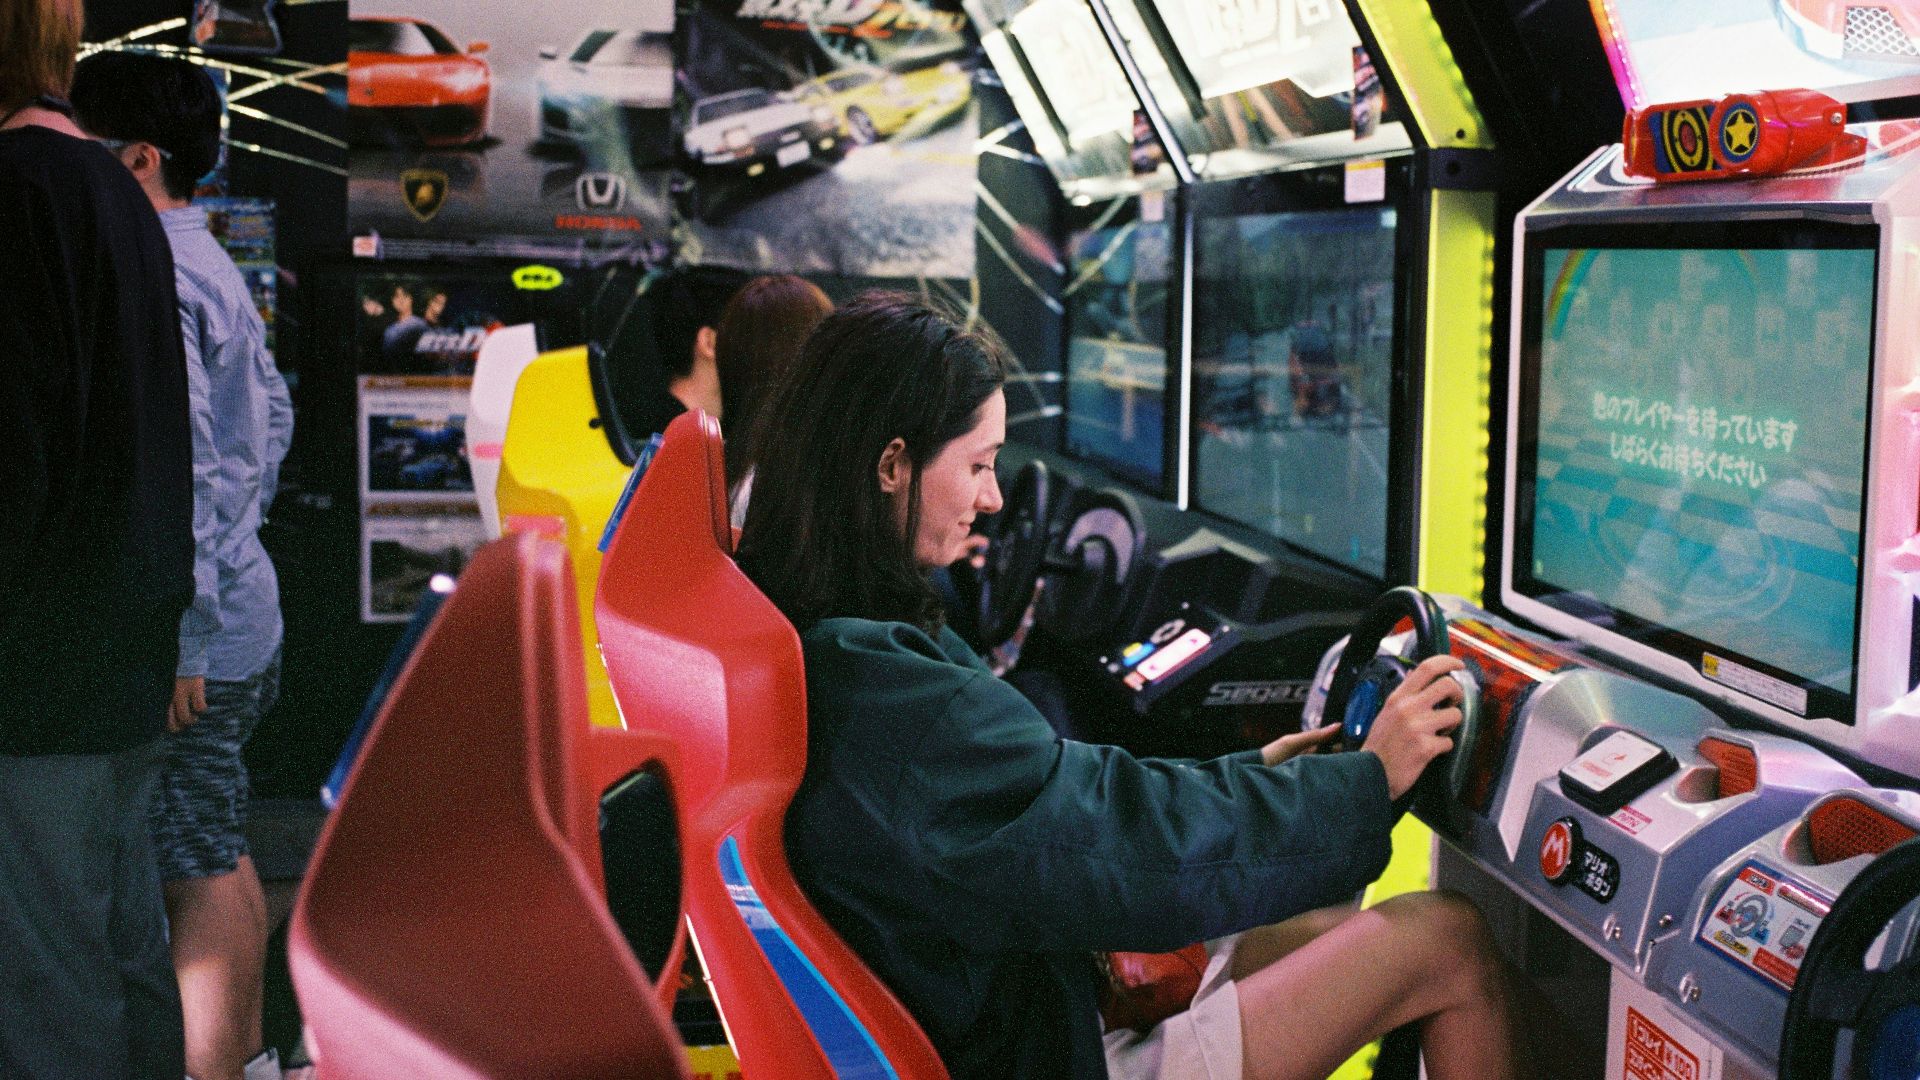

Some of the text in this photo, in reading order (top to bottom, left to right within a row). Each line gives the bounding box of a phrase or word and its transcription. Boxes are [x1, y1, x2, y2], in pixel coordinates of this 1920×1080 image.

[1593, 391, 1798, 452] 他のプレイヤーを待っています
[1610, 432, 1768, 488] しばらくお待ちください
[1542, 831, 1564, 867] M
[1584, 851, 1609, 876] マリオ
[1586, 873, 1611, 897] ボタン
